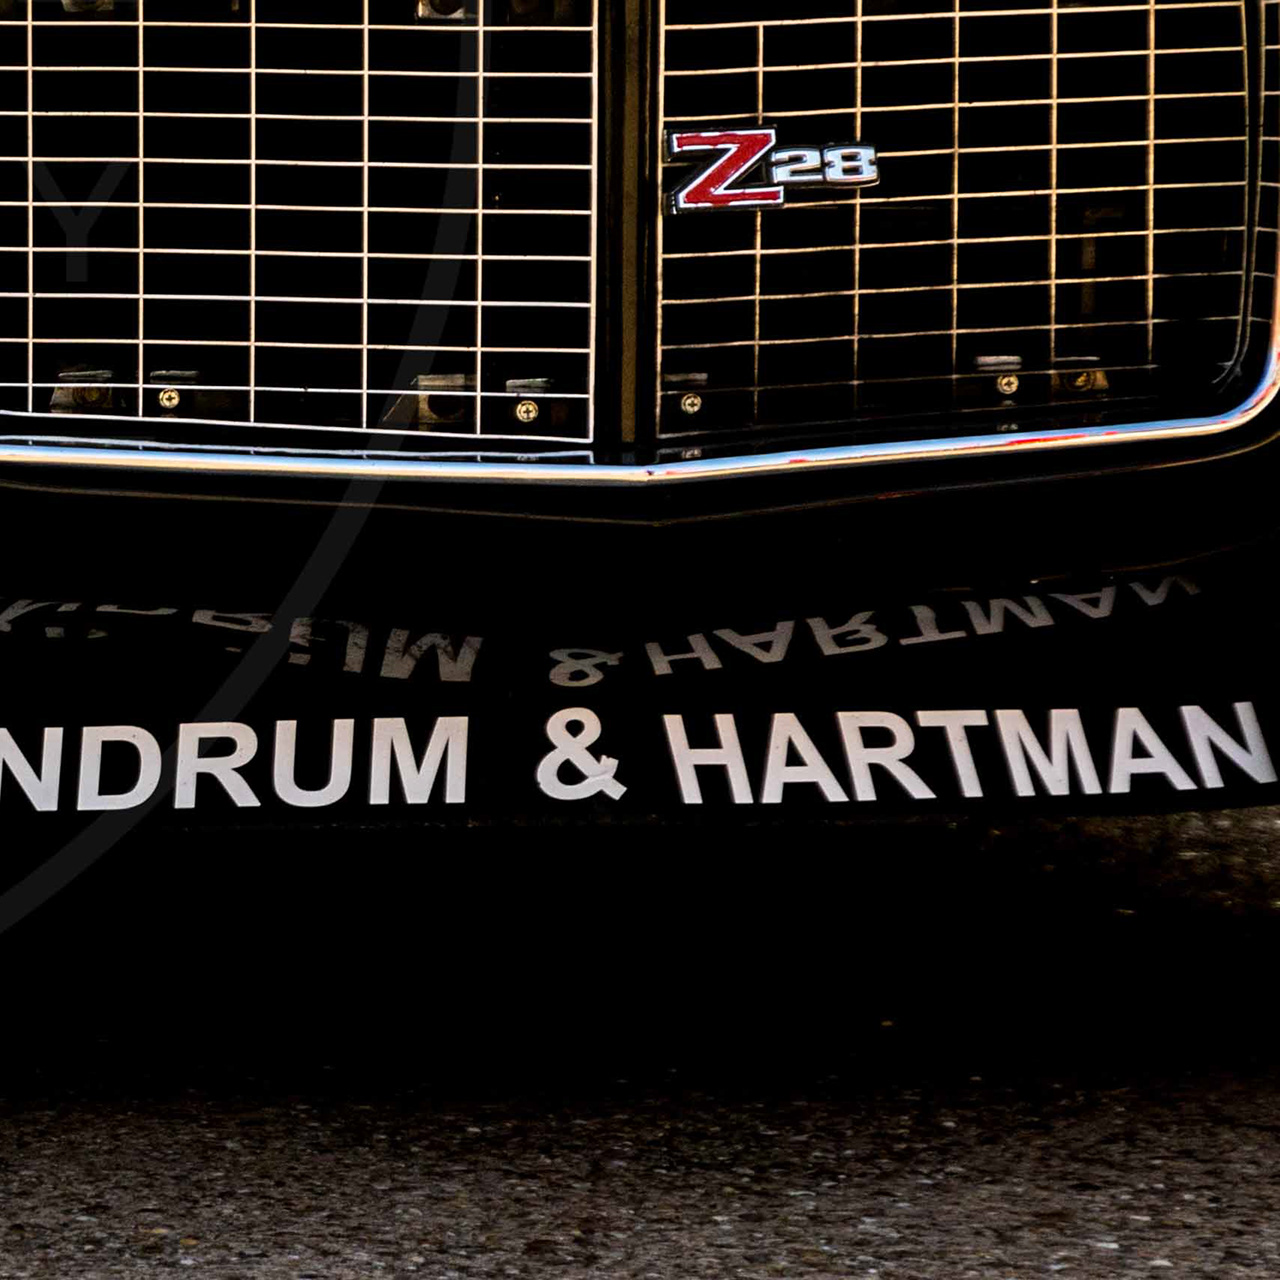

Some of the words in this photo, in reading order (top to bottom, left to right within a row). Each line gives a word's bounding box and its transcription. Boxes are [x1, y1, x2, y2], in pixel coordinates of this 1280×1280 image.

[671, 128, 882, 210] Z28
[536, 707, 628, 801] &
[662, 701, 1278, 805] HARTMAN
